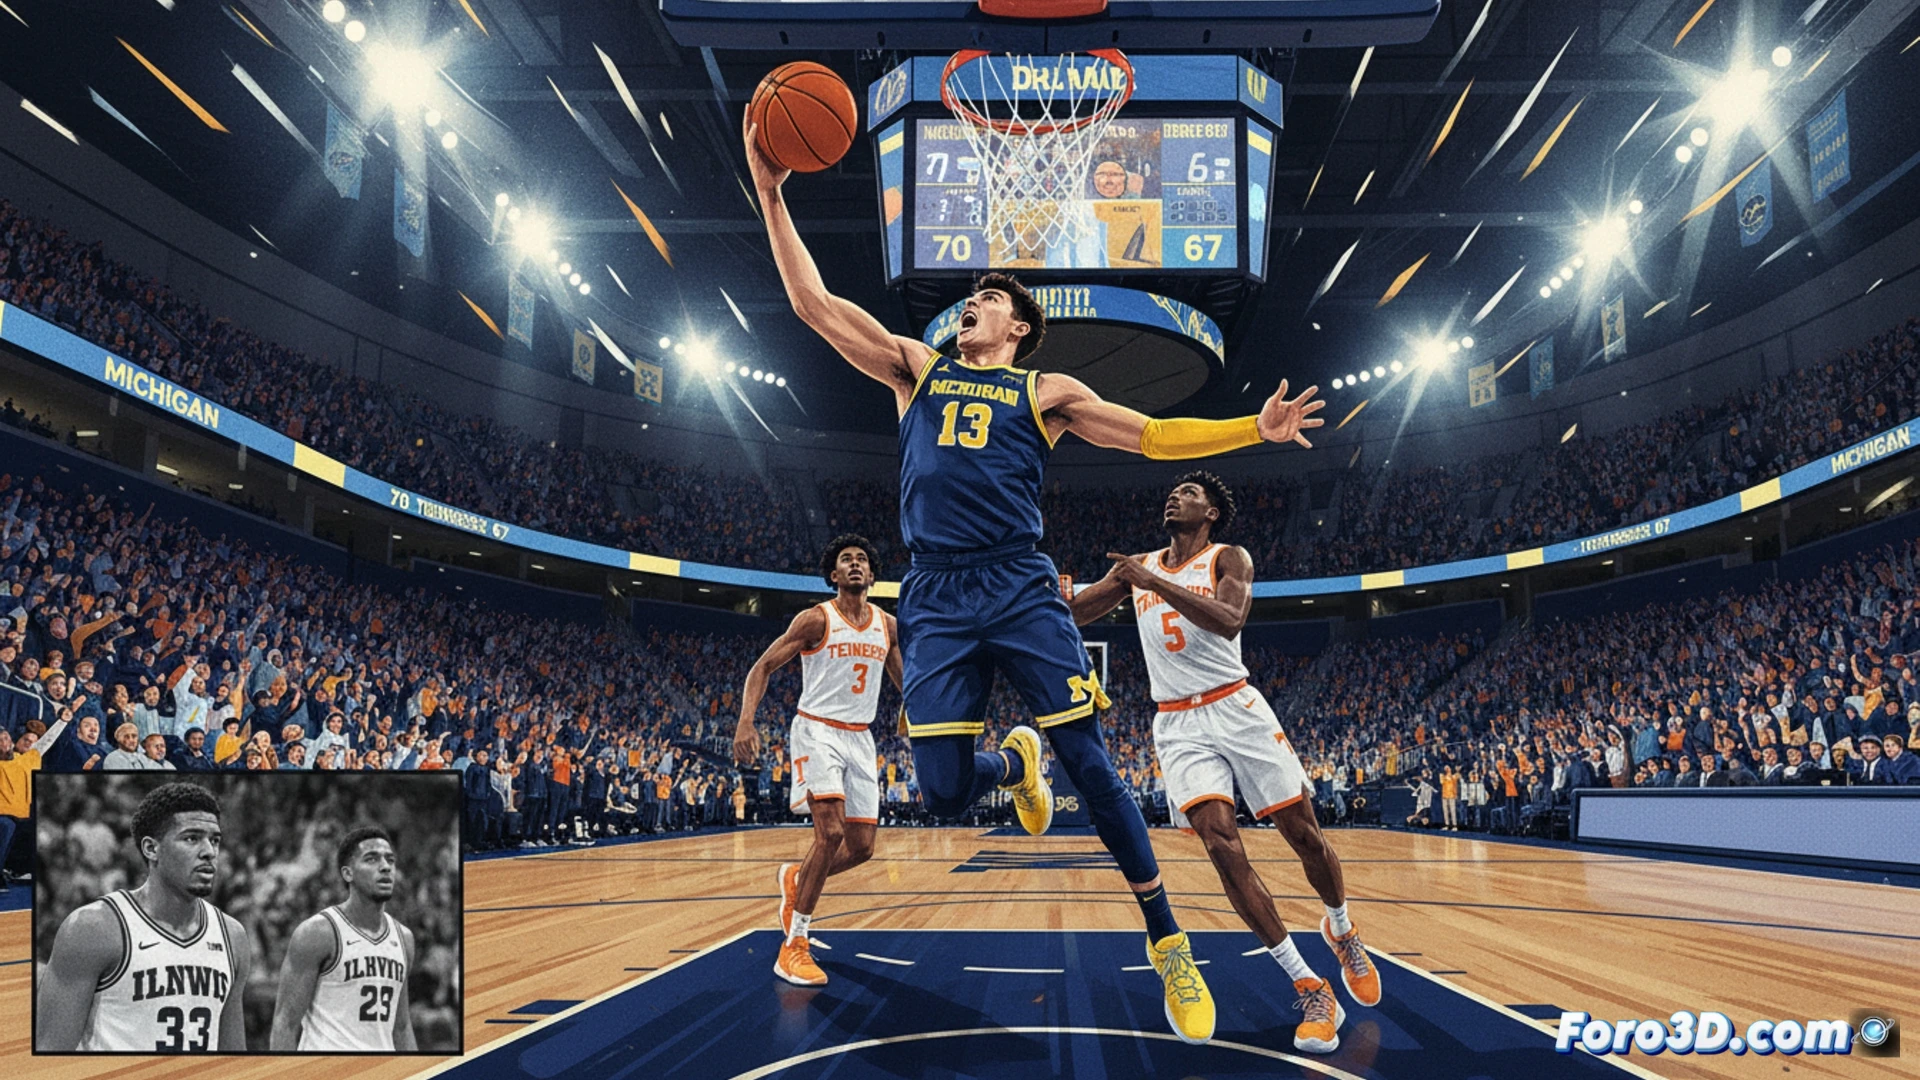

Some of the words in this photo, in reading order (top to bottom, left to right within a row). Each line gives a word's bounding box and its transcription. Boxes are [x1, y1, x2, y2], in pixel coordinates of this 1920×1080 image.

[932, 234, 971, 262] 70
[1183, 234, 1223, 262] 67
[104, 355, 220, 429] MICHIGAN
[937, 401, 993, 449] 13
[1160, 611, 1187, 653] 5
[851, 663, 869, 695] 3
[794, 755, 809, 784] T
[155, 1006, 212, 1052] 33
